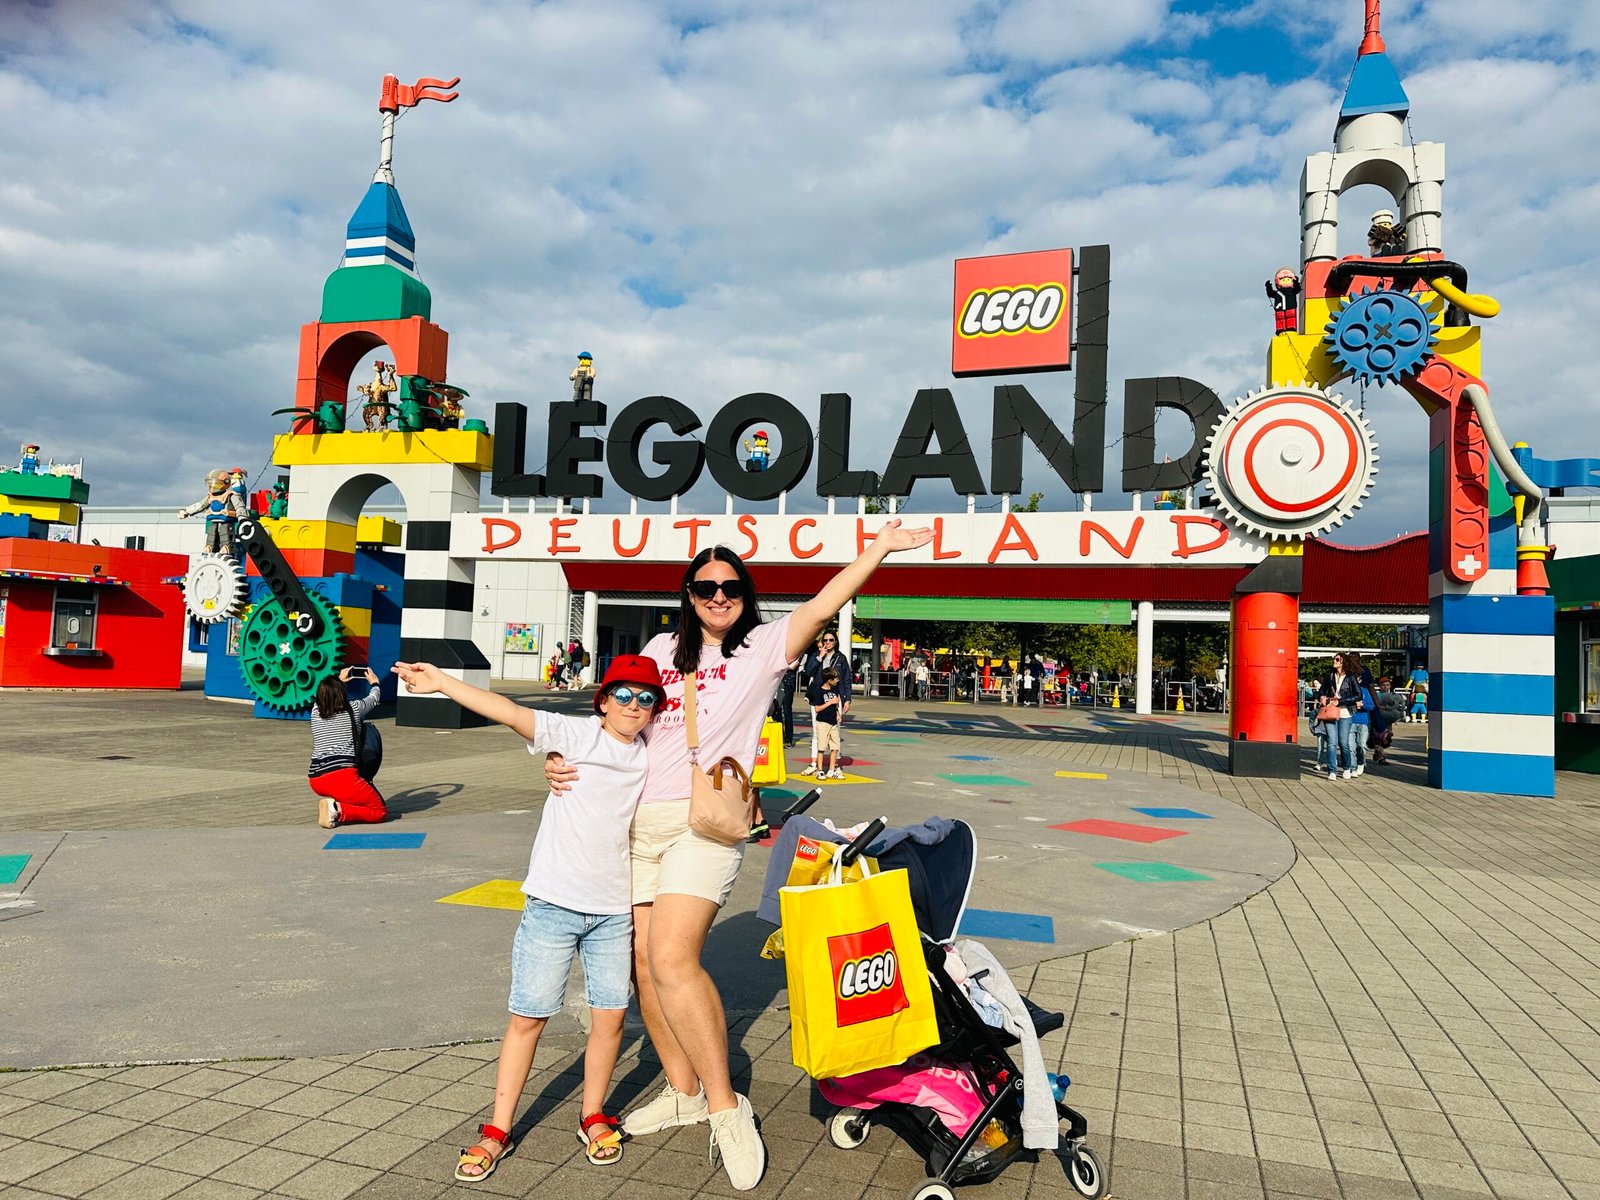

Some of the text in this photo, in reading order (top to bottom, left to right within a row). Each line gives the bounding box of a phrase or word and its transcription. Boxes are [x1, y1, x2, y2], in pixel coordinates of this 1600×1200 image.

[961, 283, 1063, 334] LEGO
[799, 844, 817, 855] LEGO
[841, 952, 895, 997] LEGO
